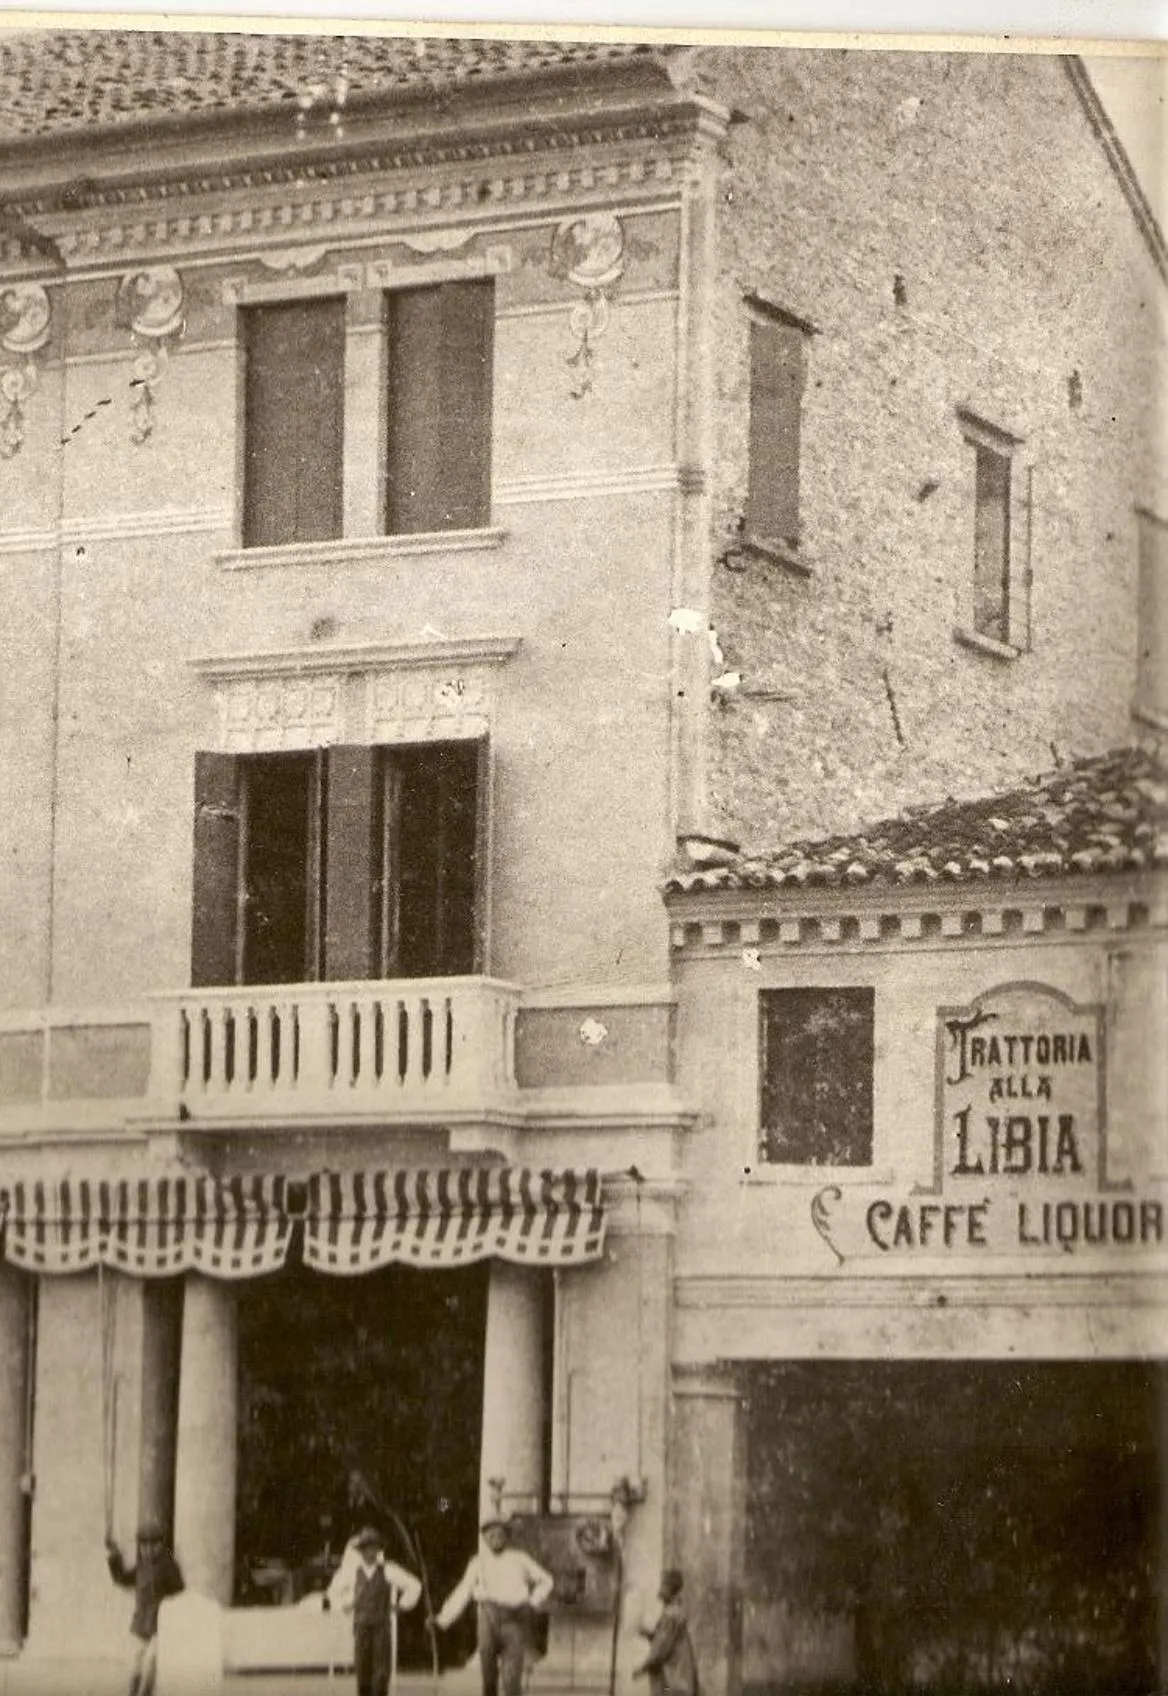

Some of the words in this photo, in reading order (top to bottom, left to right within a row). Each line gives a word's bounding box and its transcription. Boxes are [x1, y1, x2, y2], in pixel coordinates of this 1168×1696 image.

[946, 1008, 1092, 1085] TRATTORIA
[989, 1075, 1052, 1103] ALLA
[950, 1104, 1083, 1176] LIBIA
